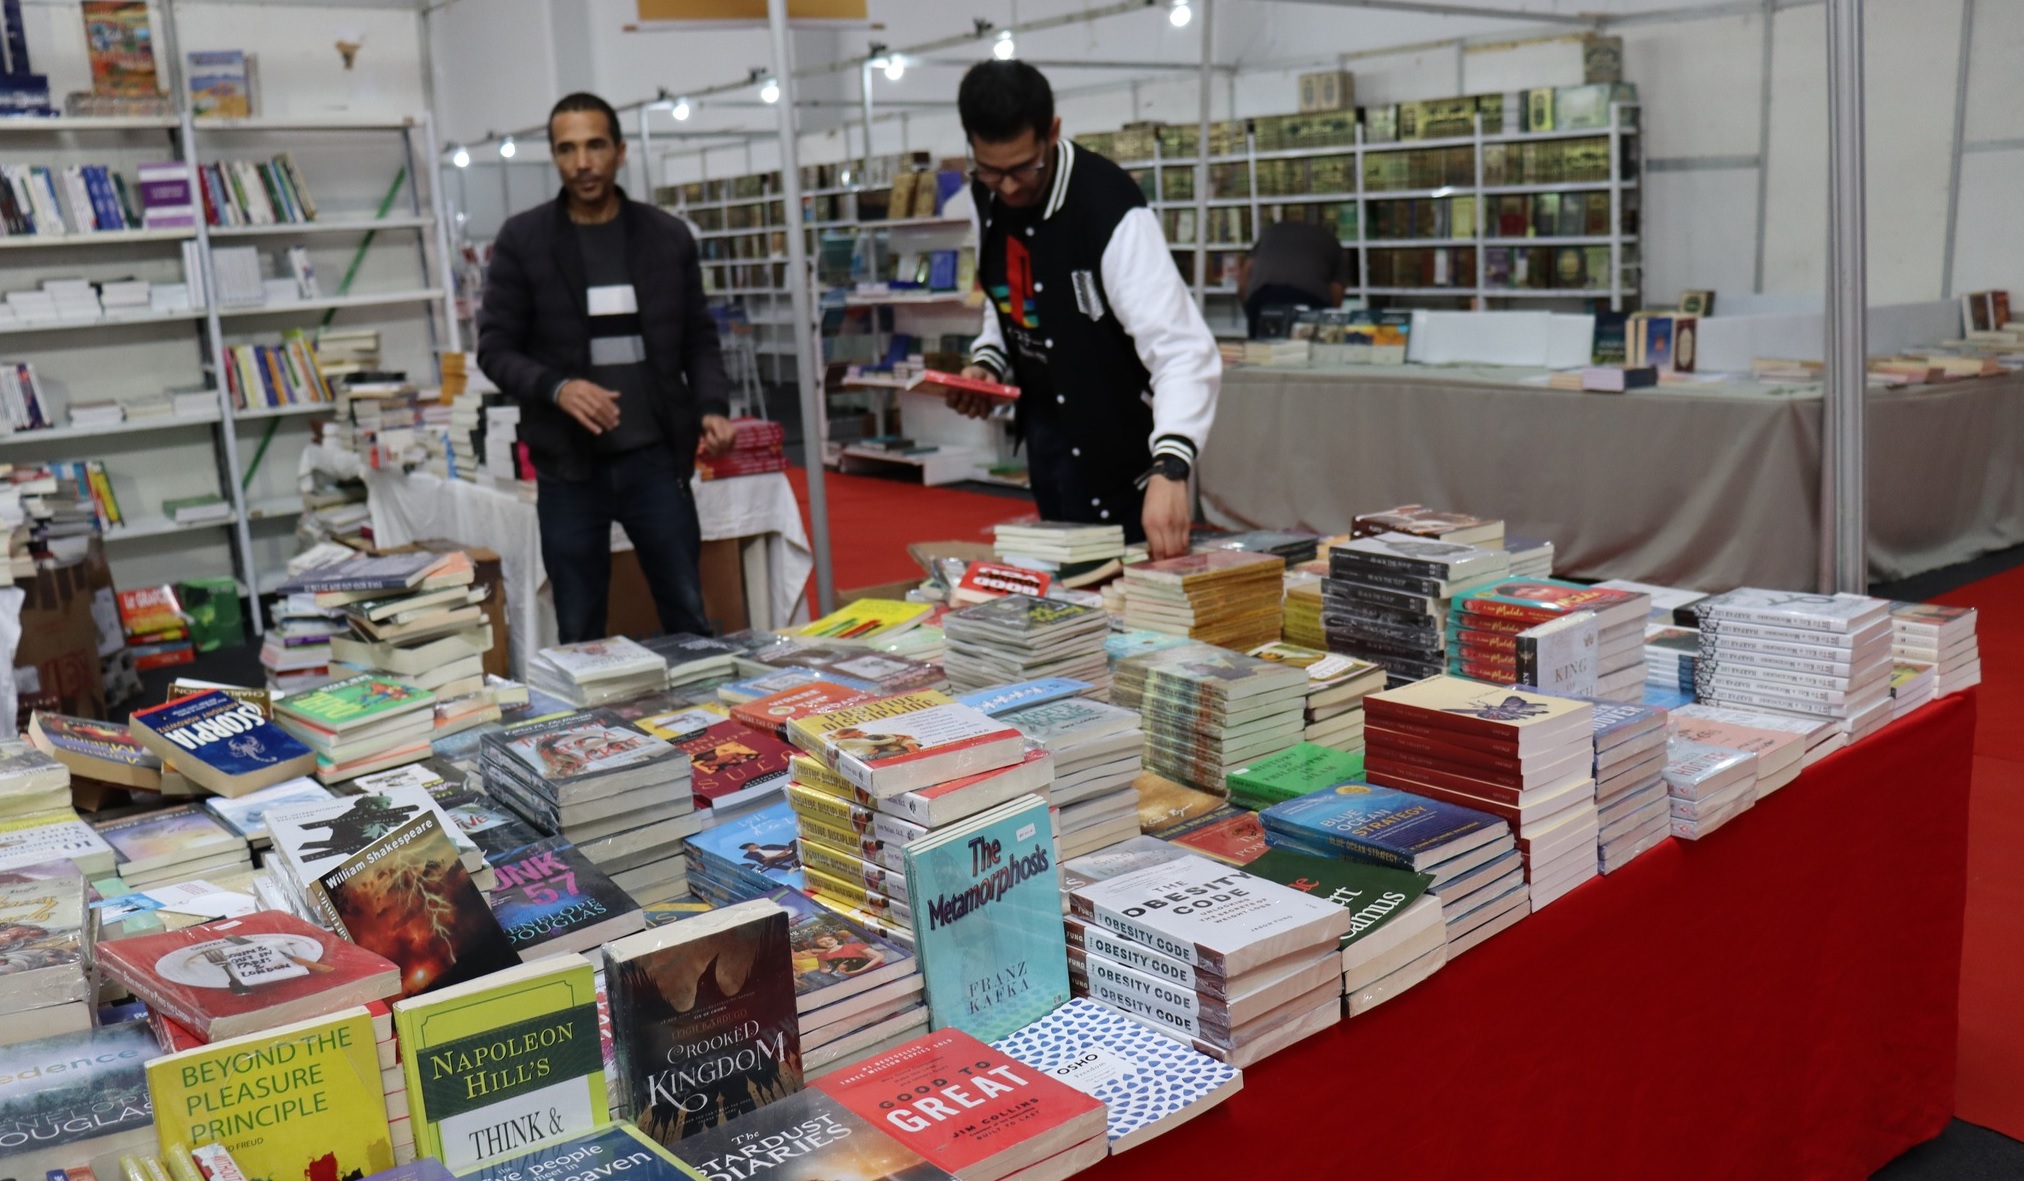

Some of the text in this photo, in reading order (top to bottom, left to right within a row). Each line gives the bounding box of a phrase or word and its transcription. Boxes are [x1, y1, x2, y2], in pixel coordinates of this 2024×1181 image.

[164, 702, 266, 750] SCORPIA
[821, 699, 938, 732] DISCIPLINE
[824, 695, 920, 722] POSITIVE
[1320, 809, 1365, 828] BLUE
[1336, 808, 1393, 831] OCEAN
[1351, 805, 1427, 837] STRATEGY
[325, 860, 366, 890] William
[366, 818, 434, 865] Shakespeare
[967, 835, 1002, 877] The
[522, 871, 582, 906] 57
[927, 843, 1049, 931] Metamorphosis
[1121, 871, 1253, 918] OBESITY
[1152, 880, 1189, 893] THE
[1173, 888, 1251, 915] CODE
[503, 898, 598, 934] ENELOPE
[1104, 916, 1153, 945] OBESITY
[1157, 938, 1190, 960] CODE
[241, 963, 292, 977] LONDON
[968, 961, 1028, 998] FRANZ
[1095, 940, 1148, 967] OBESITY
[1151, 960, 1187, 982] CODE
[968, 978, 1029, 1015] KAFKA
[1097, 967, 1150, 994] OBESITY
[1154, 988, 1191, 1009] CODE
[1100, 987, 1152, 1015] OBESITY
[1156, 1009, 1192, 1030] CODE
[182, 1026, 352, 1088] BEYOND THE
[430, 1023, 575, 1081] NAPOLEON
[667, 1020, 759, 1065] CROOKED
[464, 1057, 551, 1100] HILL'S
[648, 1031, 786, 1113] KINGDOM
[878, 1078, 948, 1110] GOOD
[959, 1060, 991, 1076] TO
[1057, 1054, 1098, 1075] OSHO
[186, 1063, 325, 1117] PLEASURE
[886, 1065, 1029, 1133] GREAT
[191, 1092, 328, 1145] PRINCIPLE
[469, 1107, 565, 1161] THINK &
[731, 1131, 760, 1146] The
[952, 1125, 976, 1139] JIM
[981, 1098, 1039, 1125] COLLINS
[236, 1137, 264, 1150] FREUD
[528, 1144, 604, 1177] people
[547, 1151, 653, 1181] eaven
